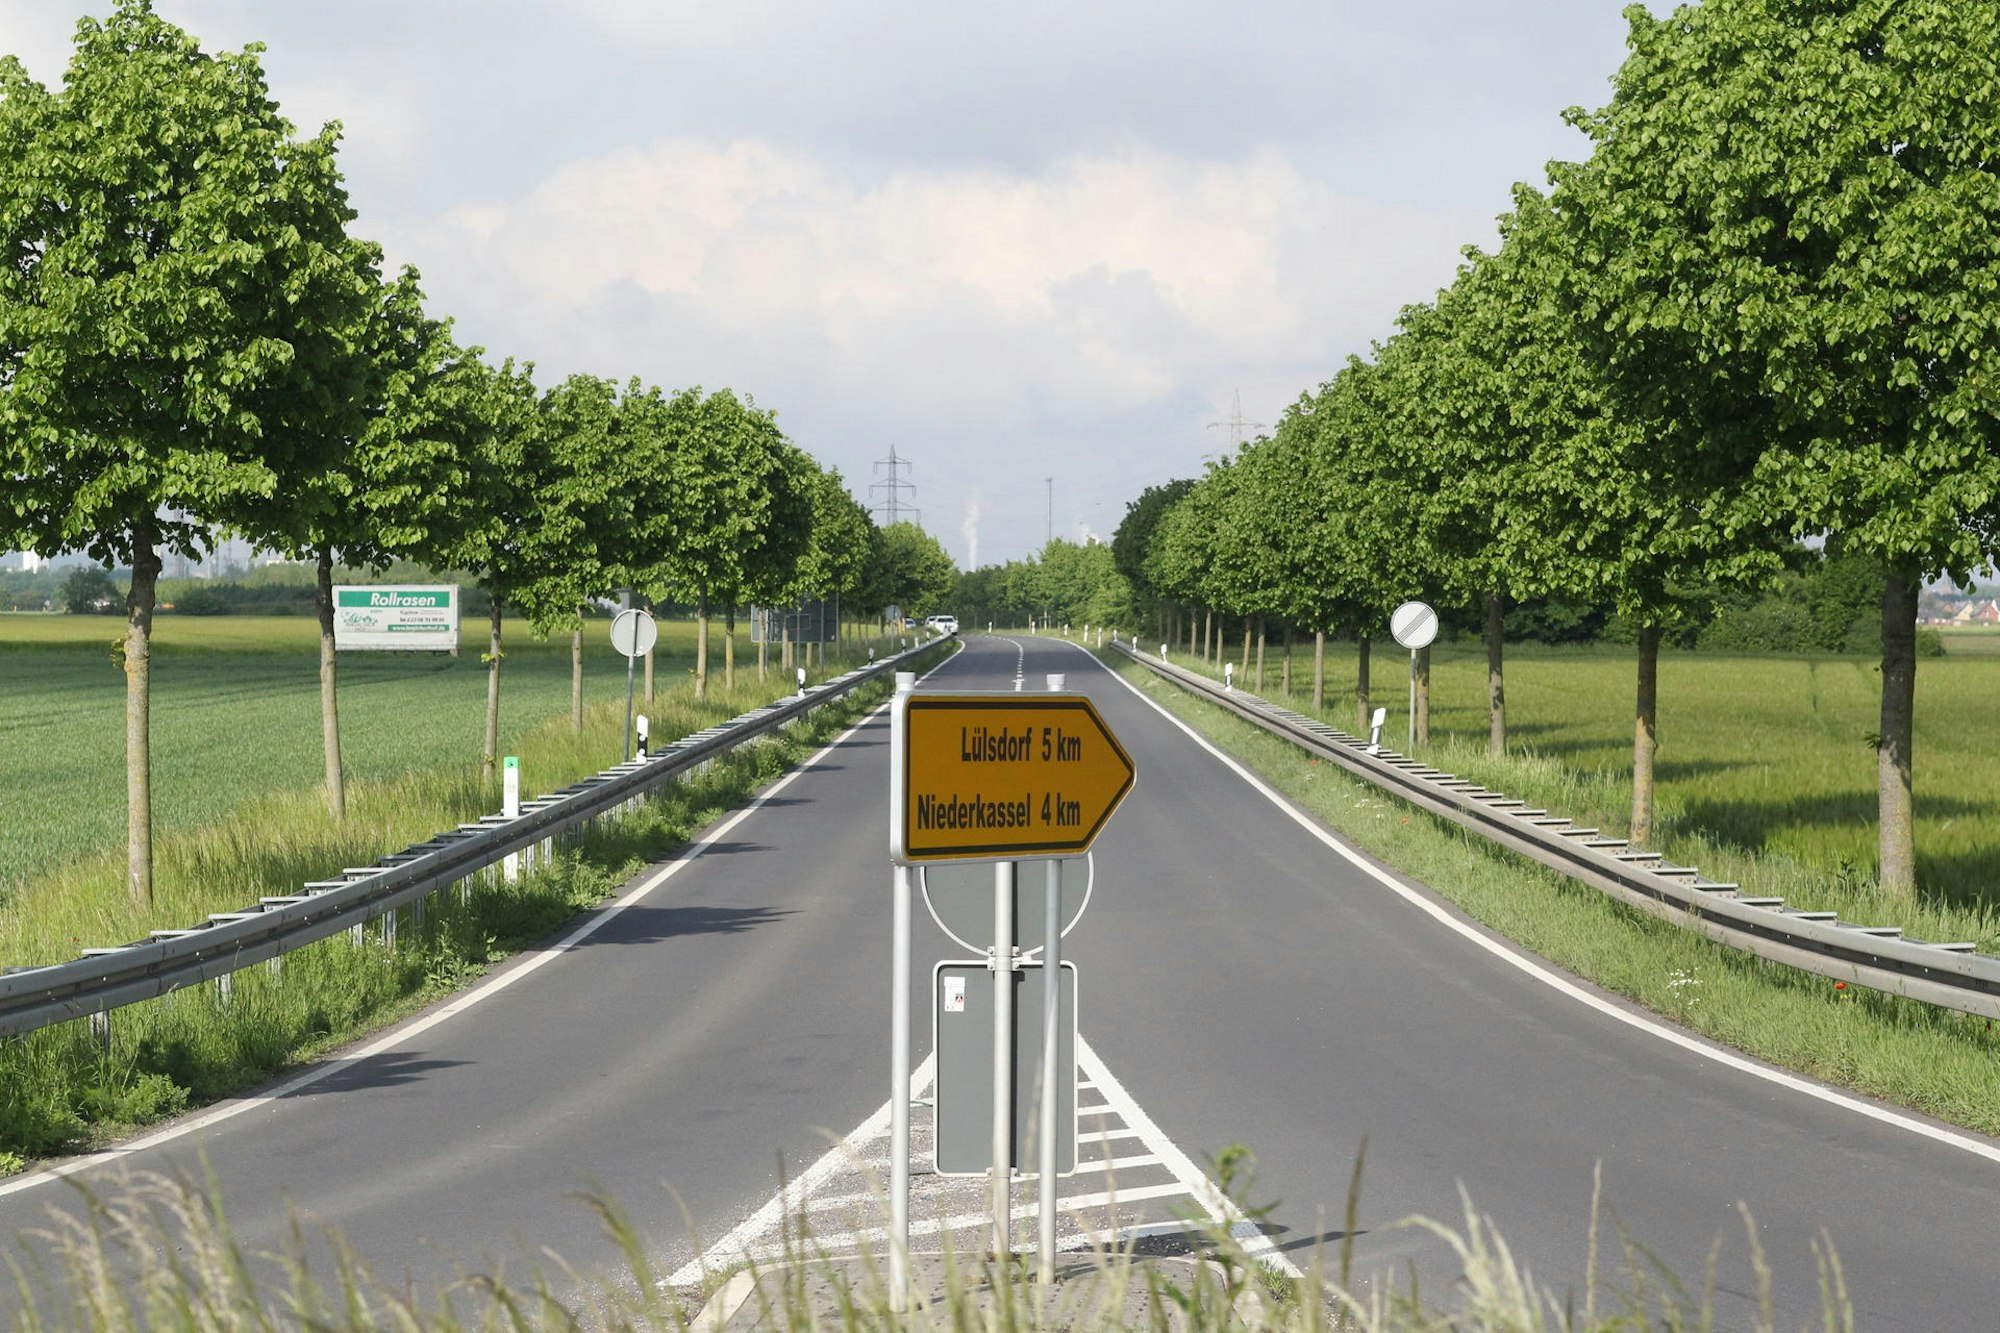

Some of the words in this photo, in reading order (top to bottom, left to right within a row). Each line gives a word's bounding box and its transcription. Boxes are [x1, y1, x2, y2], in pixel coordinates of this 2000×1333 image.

[370, 591, 436, 606] Rollrasen
[961, 727, 1032, 762] Lülsdorf
[1042, 727, 1052, 762] 5
[1057, 727, 1081, 761] km
[917, 793, 1031, 829] Niederkassel
[1041, 792, 1052, 826] 4
[1057, 793, 1080, 826] km
